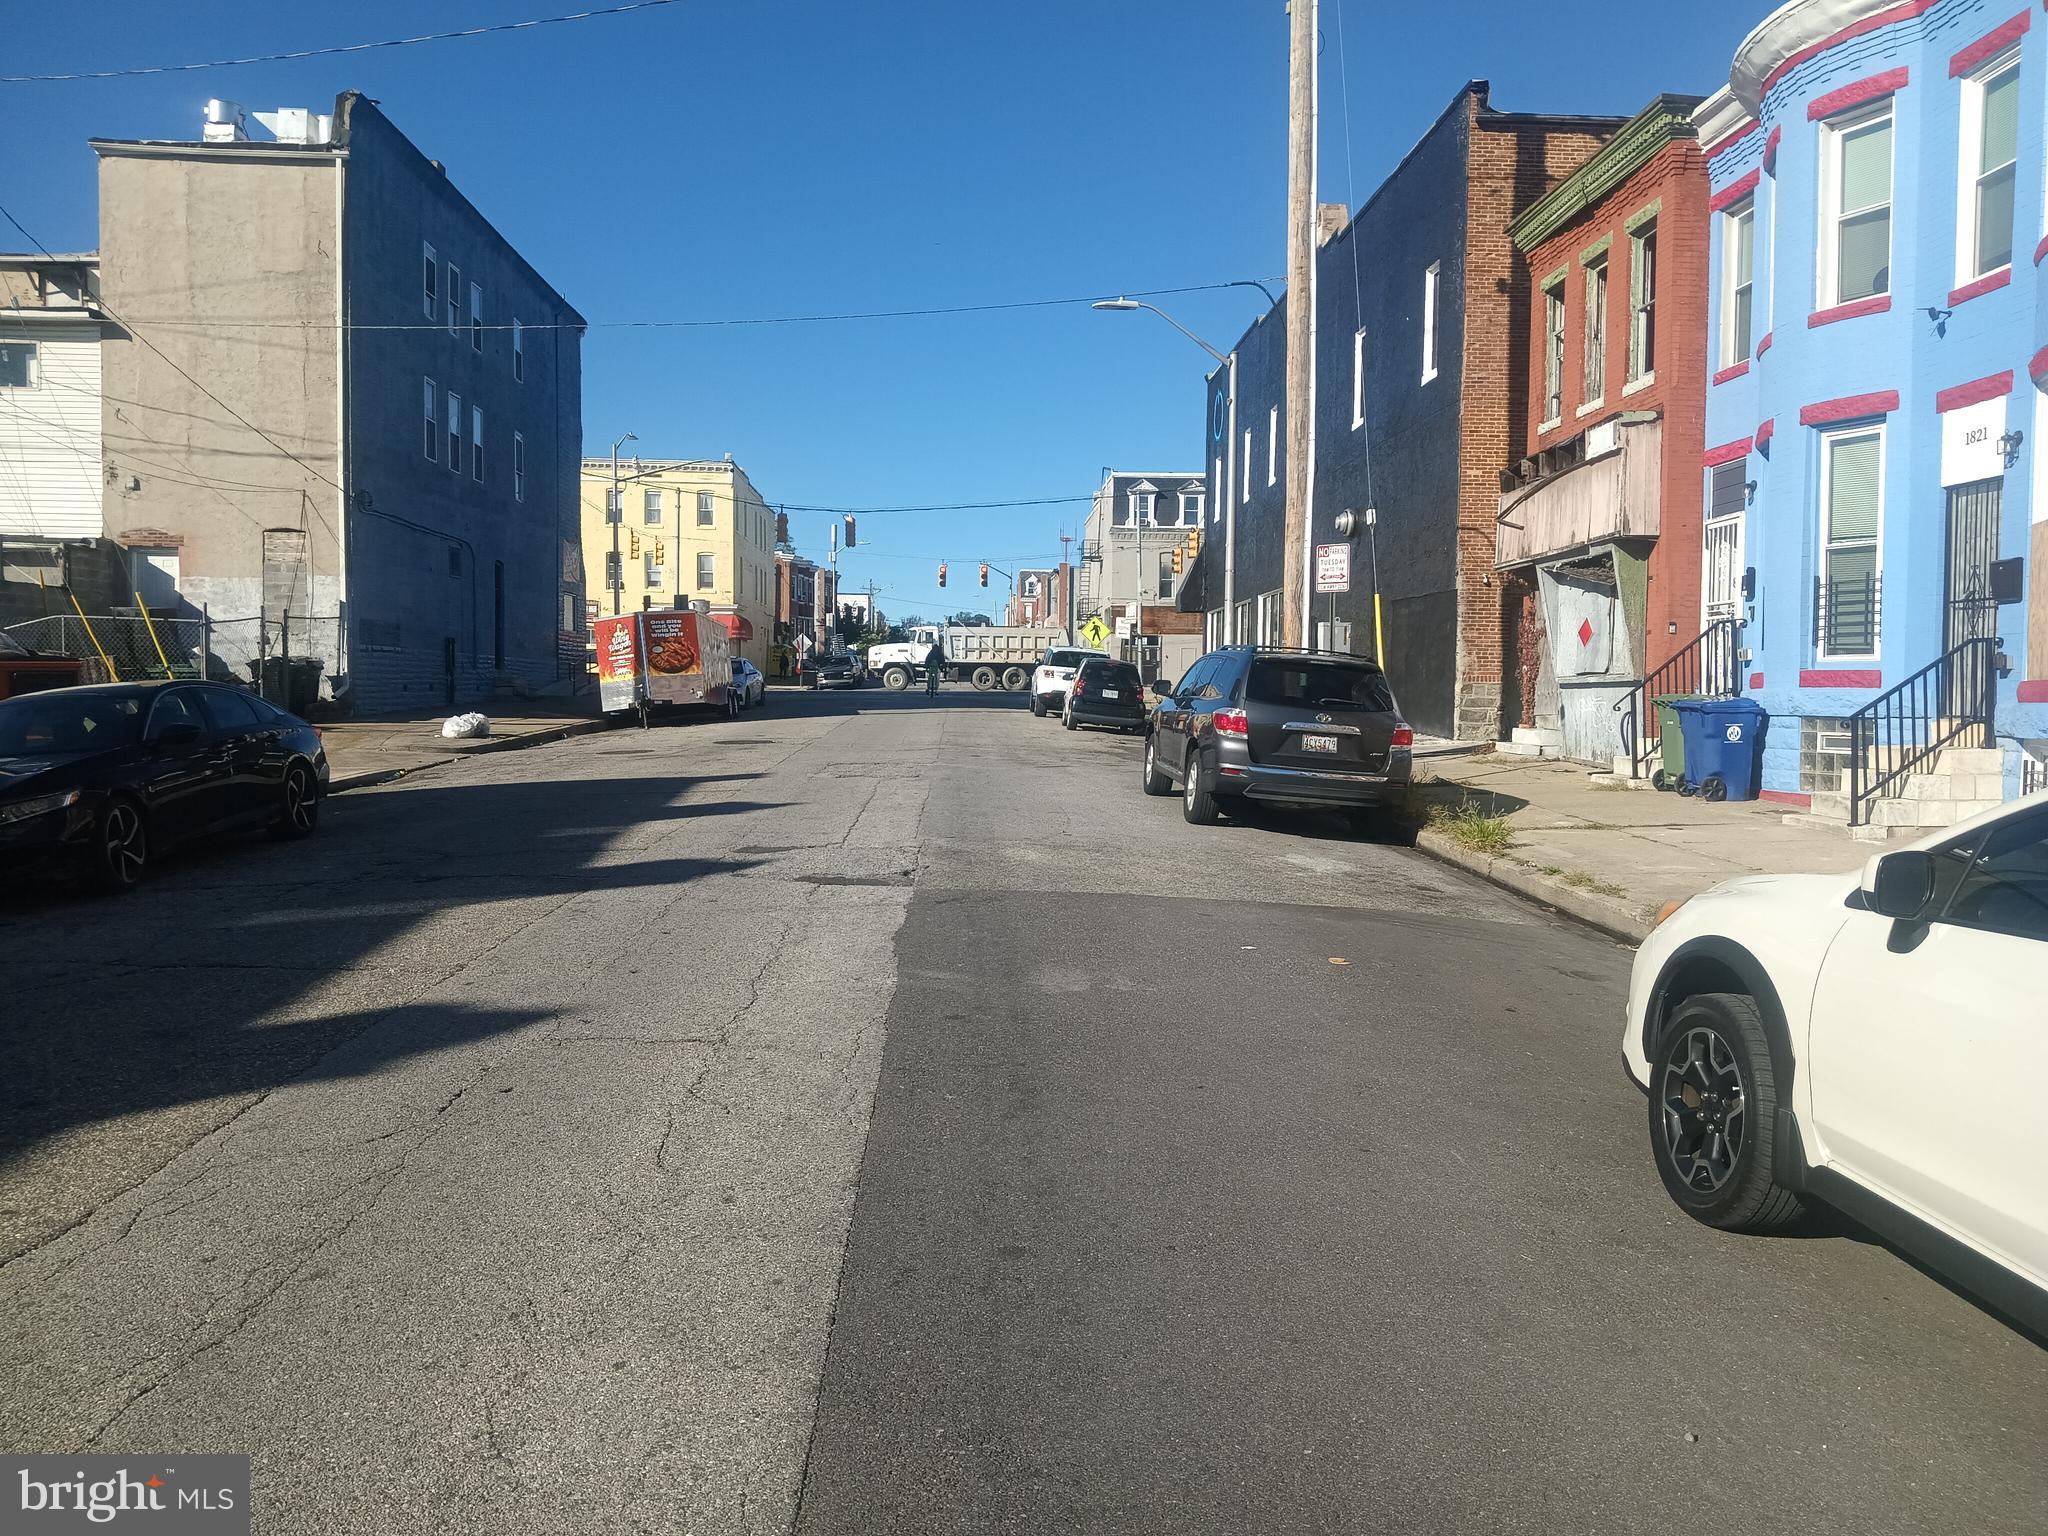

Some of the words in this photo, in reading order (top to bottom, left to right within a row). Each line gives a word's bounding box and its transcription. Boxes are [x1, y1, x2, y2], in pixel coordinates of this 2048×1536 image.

[1965, 427, 1988, 446] 1821
[1318, 546, 1329, 557] NO
[1330, 547, 1347, 555] PARKING
